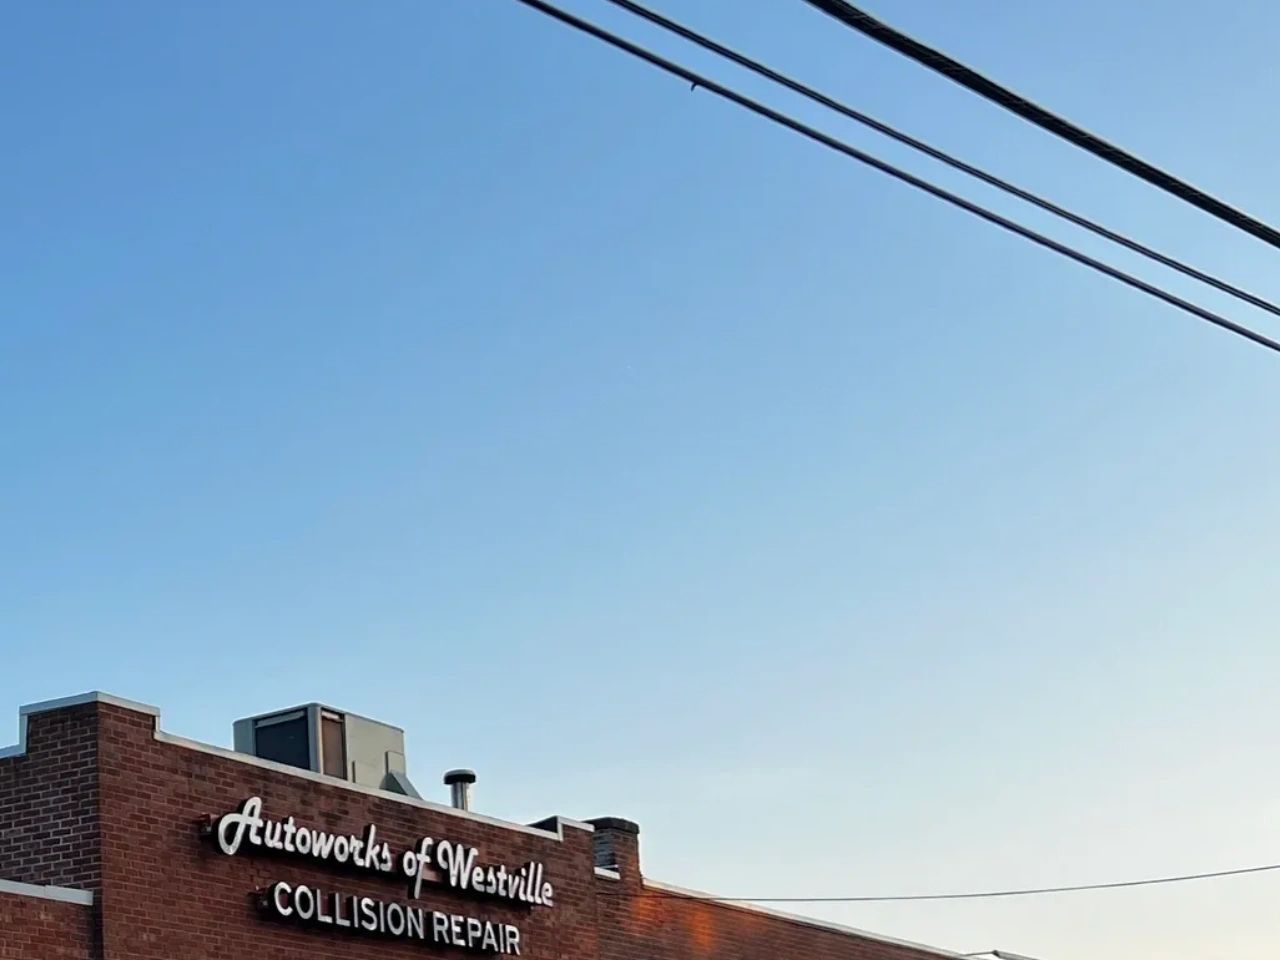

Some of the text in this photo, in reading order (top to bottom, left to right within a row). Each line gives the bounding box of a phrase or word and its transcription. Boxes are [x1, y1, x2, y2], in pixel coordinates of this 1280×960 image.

[218, 796, 554, 907] Autoworks of Westville
[273, 881, 521, 955] COLLISION REPAIR
